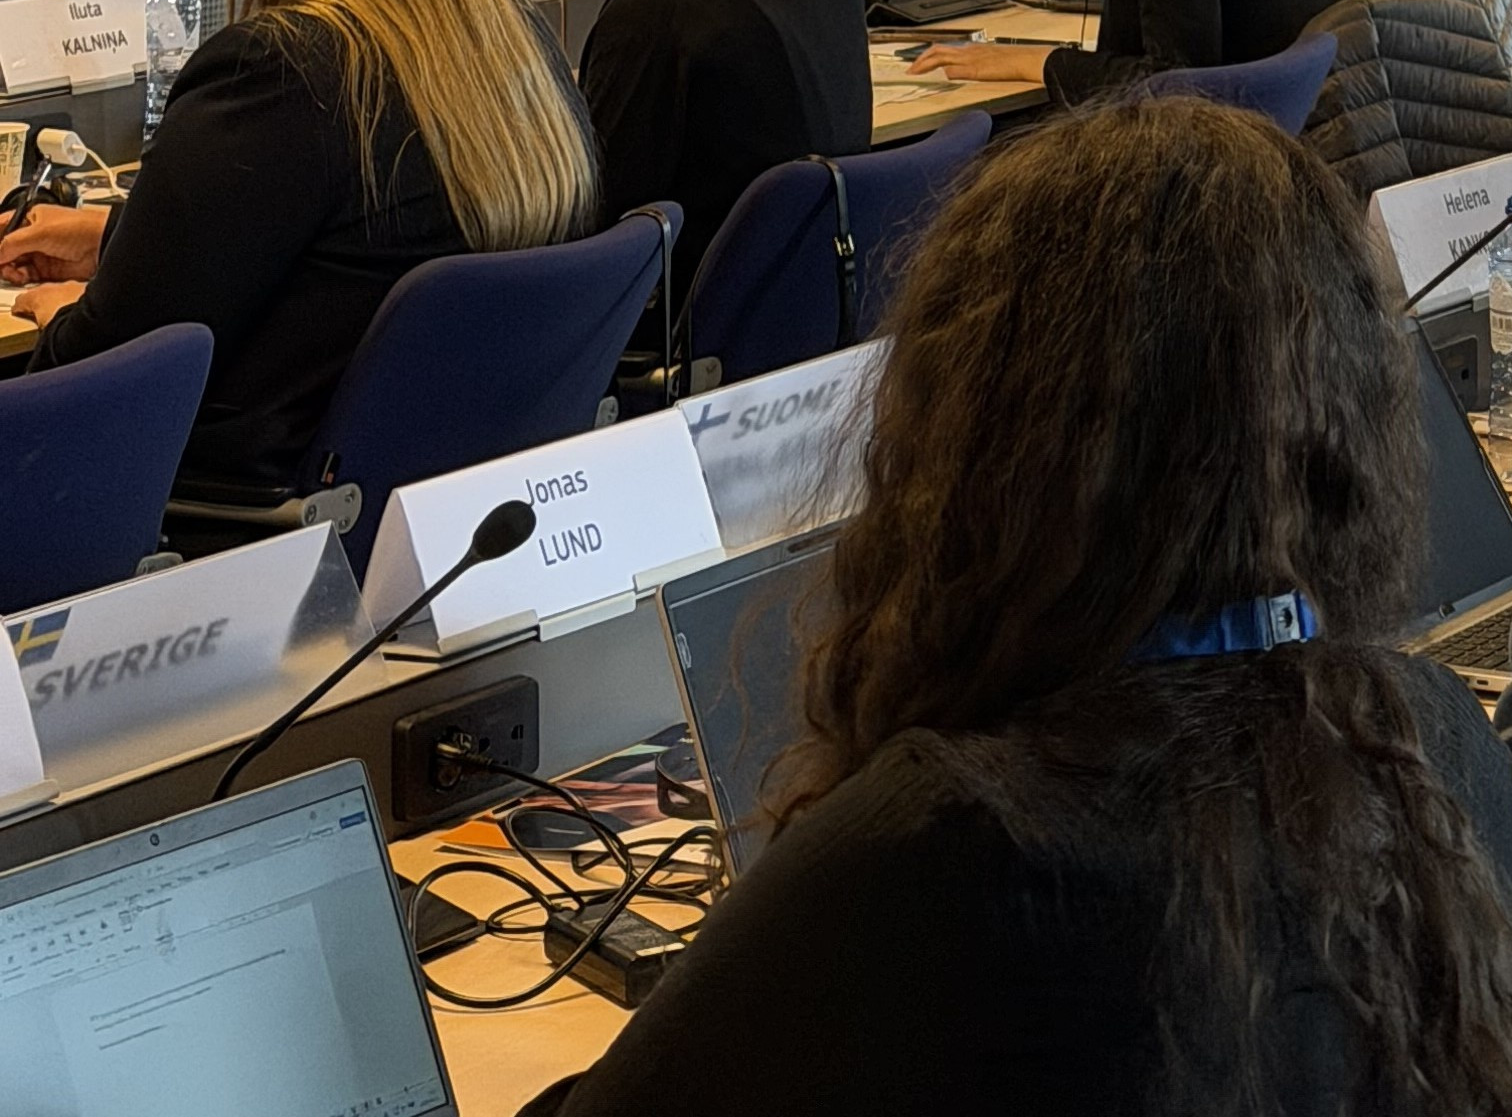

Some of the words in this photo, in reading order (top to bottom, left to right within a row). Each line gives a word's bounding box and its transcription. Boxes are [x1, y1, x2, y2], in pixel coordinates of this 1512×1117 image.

[68, 2, 103, 21] Iluta
[62, 29, 128, 56] KALNIŅA
[1443, 187, 1491, 215] Helena
[525, 470, 589, 507] Jonas
[538, 523, 603, 567] LUND
[30, 617, 229, 708] SVERIGE
